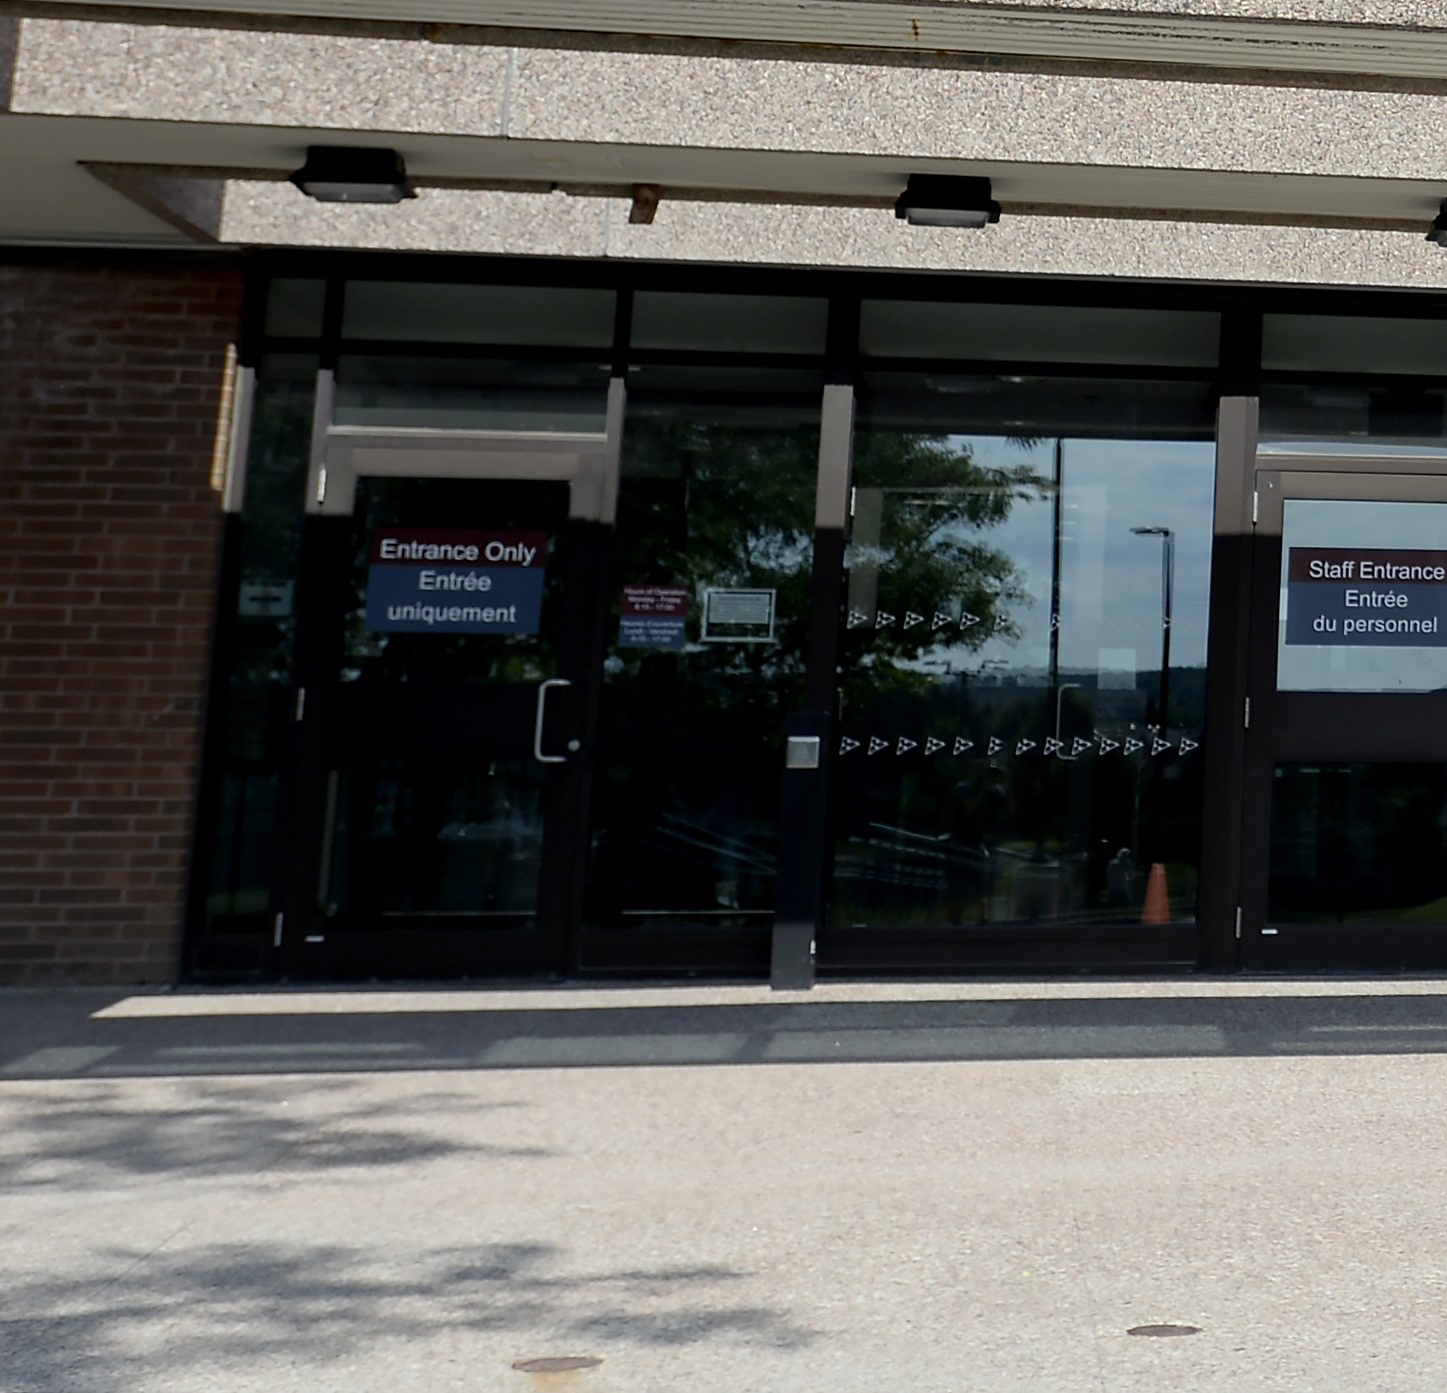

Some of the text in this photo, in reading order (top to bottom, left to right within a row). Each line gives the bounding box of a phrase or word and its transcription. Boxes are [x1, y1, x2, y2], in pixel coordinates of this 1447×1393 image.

[380, 538, 537, 566] Entrance Only
[419, 569, 492, 592] Entrée
[1309, 560, 1446, 580] Staff Entrance
[1345, 589, 1408, 608] Entrée
[387, 601, 517, 626] uniquement
[1313, 615, 1438, 636] du personnel
